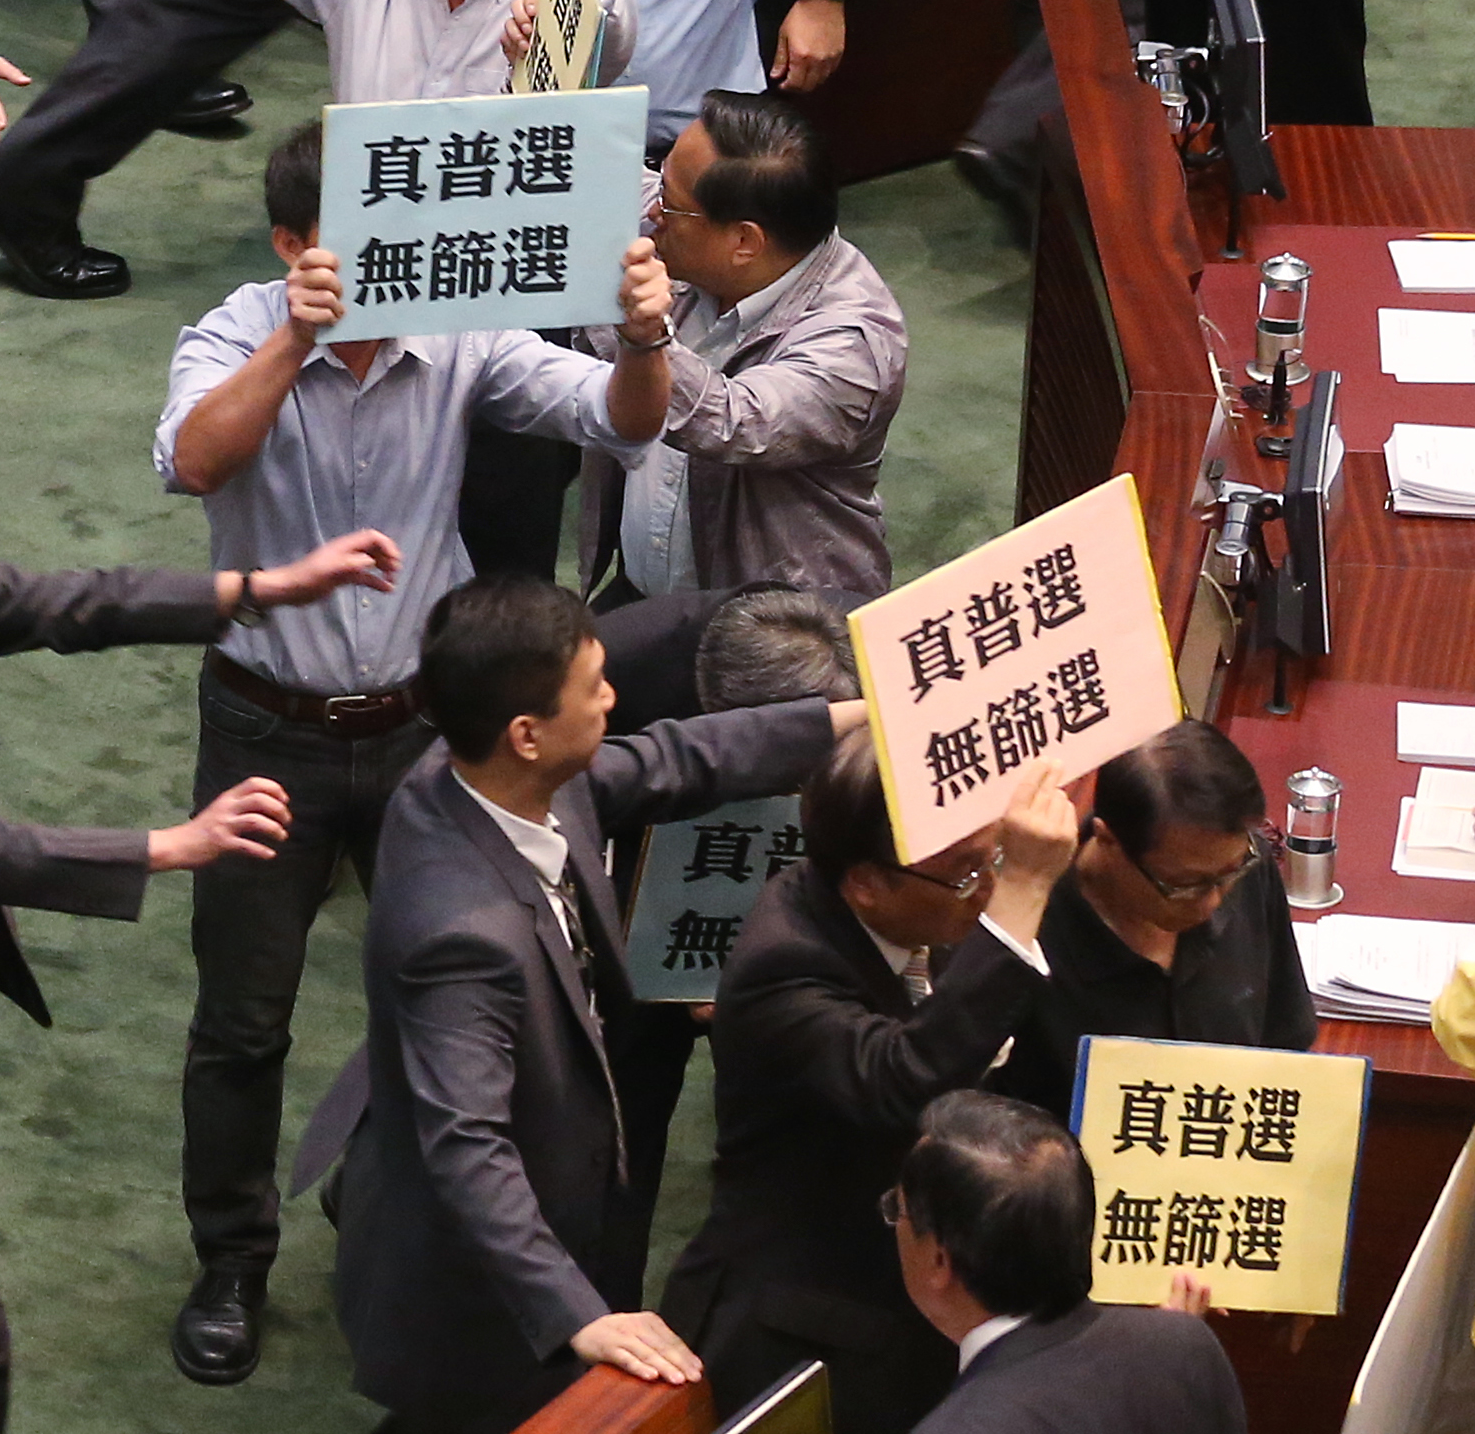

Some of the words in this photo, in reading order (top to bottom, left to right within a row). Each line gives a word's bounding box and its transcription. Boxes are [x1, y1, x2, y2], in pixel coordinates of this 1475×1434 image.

[361, 124, 575, 207] 真普選
[354, 224, 569, 306] 無篩選
[899, 543, 1086, 704] 真普選
[925, 648, 1109, 807] 無篩選
[662, 909, 743, 970] 無
[1113, 1080, 1300, 1163] 真普選
[1100, 1188, 1286, 1271] 無篩選
